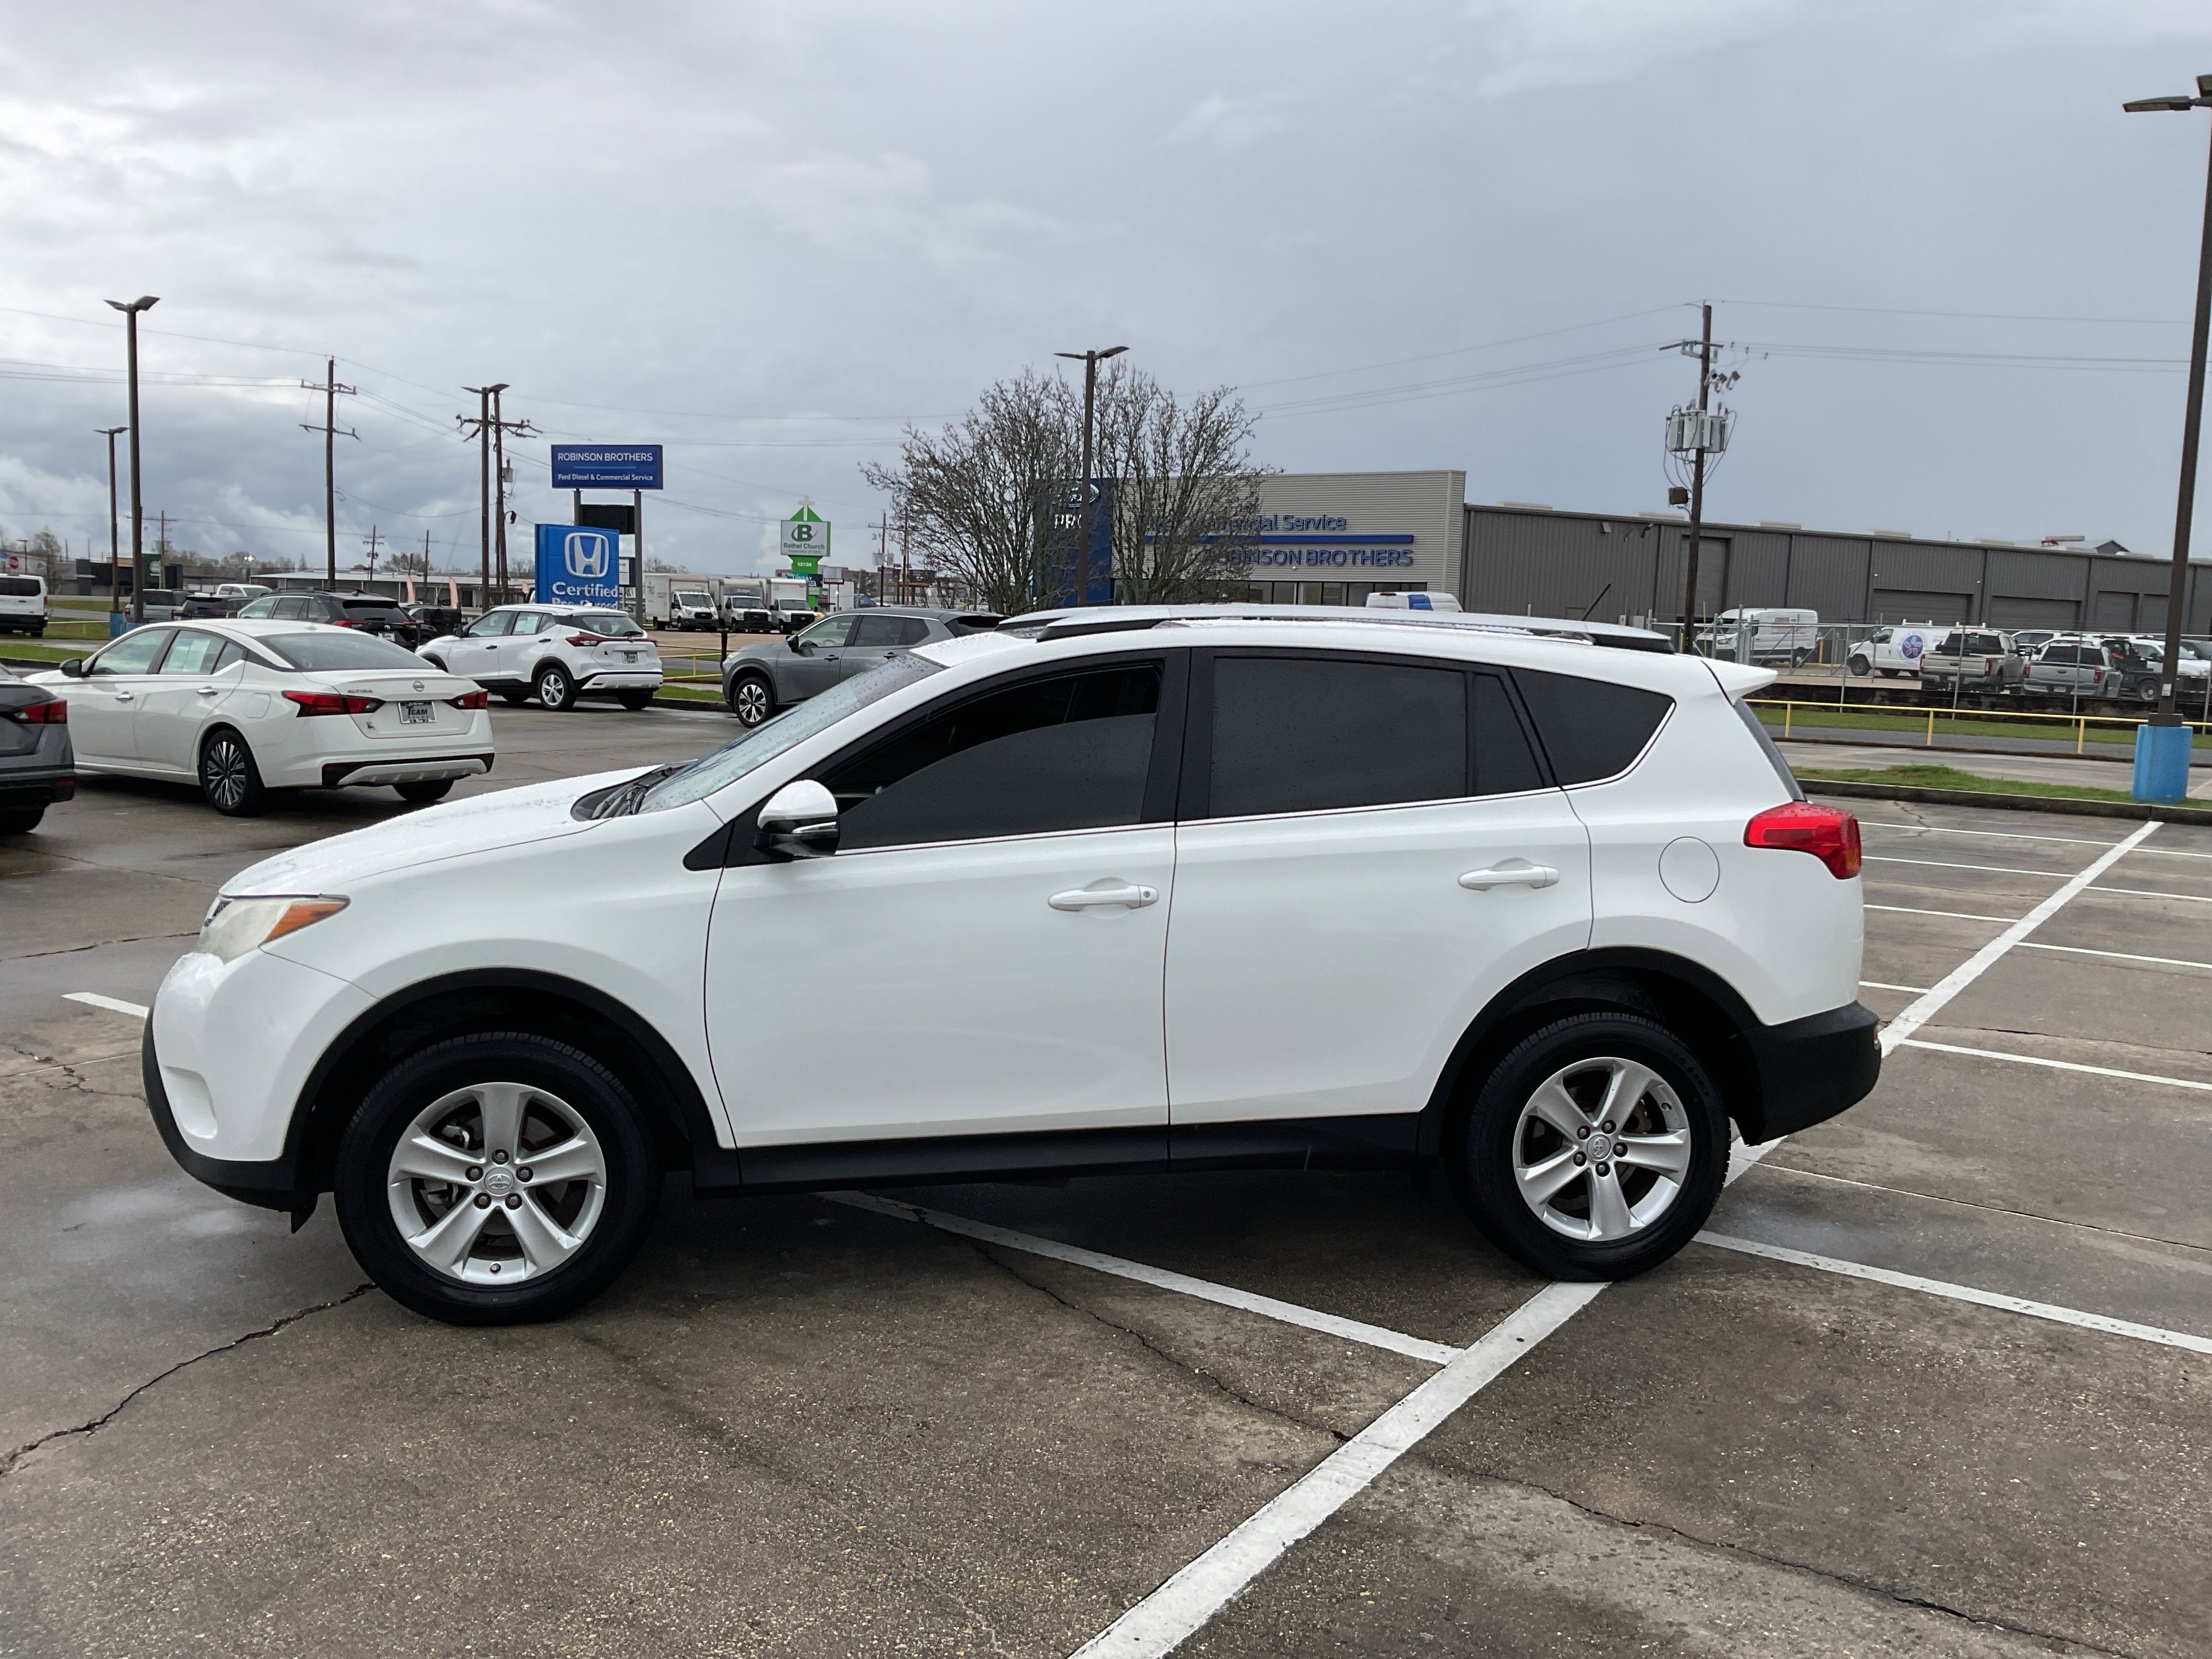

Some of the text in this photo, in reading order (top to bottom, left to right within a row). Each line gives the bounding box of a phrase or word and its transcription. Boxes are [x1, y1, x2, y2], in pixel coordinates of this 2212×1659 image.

[558, 453, 653, 461] ROBINSON BROTHERS
[1282, 514, 1346, 531] Service
[1306, 549, 1413, 566] BROTHERS
[552, 581, 618, 598] Certified
[406, 706, 428, 715] TEAM
